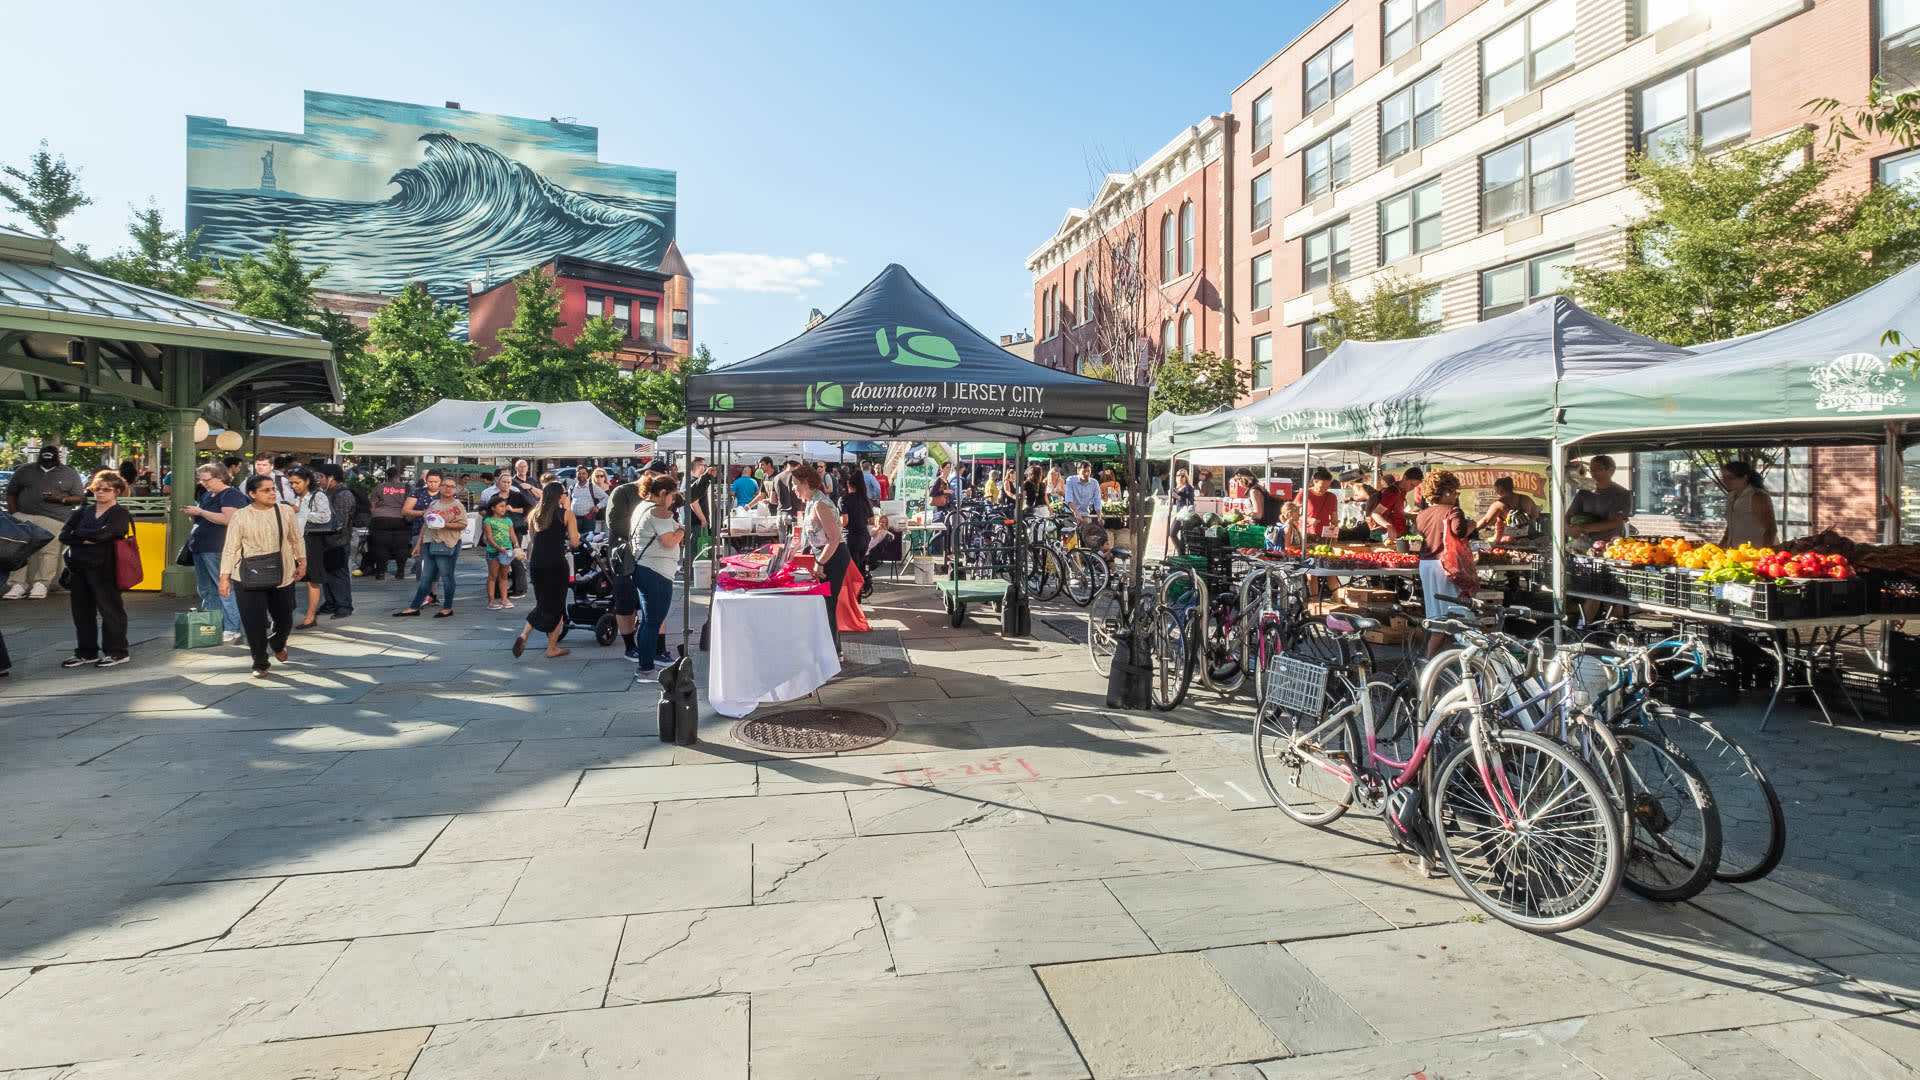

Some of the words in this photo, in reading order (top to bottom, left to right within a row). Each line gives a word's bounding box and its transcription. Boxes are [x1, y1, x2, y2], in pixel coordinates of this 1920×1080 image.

[851, 381, 937, 399] downtown
[952, 382, 1007, 401] JERSEY
[1012, 385, 1044, 403] CITY
[852, 403, 893, 412] historic
[896, 403, 934, 414] special
[937, 403, 1005, 416] improvement
[1007, 407, 1044, 419] district
[1031, 441, 1059, 452] ORT
[1063, 442, 1107, 453] FARMS
